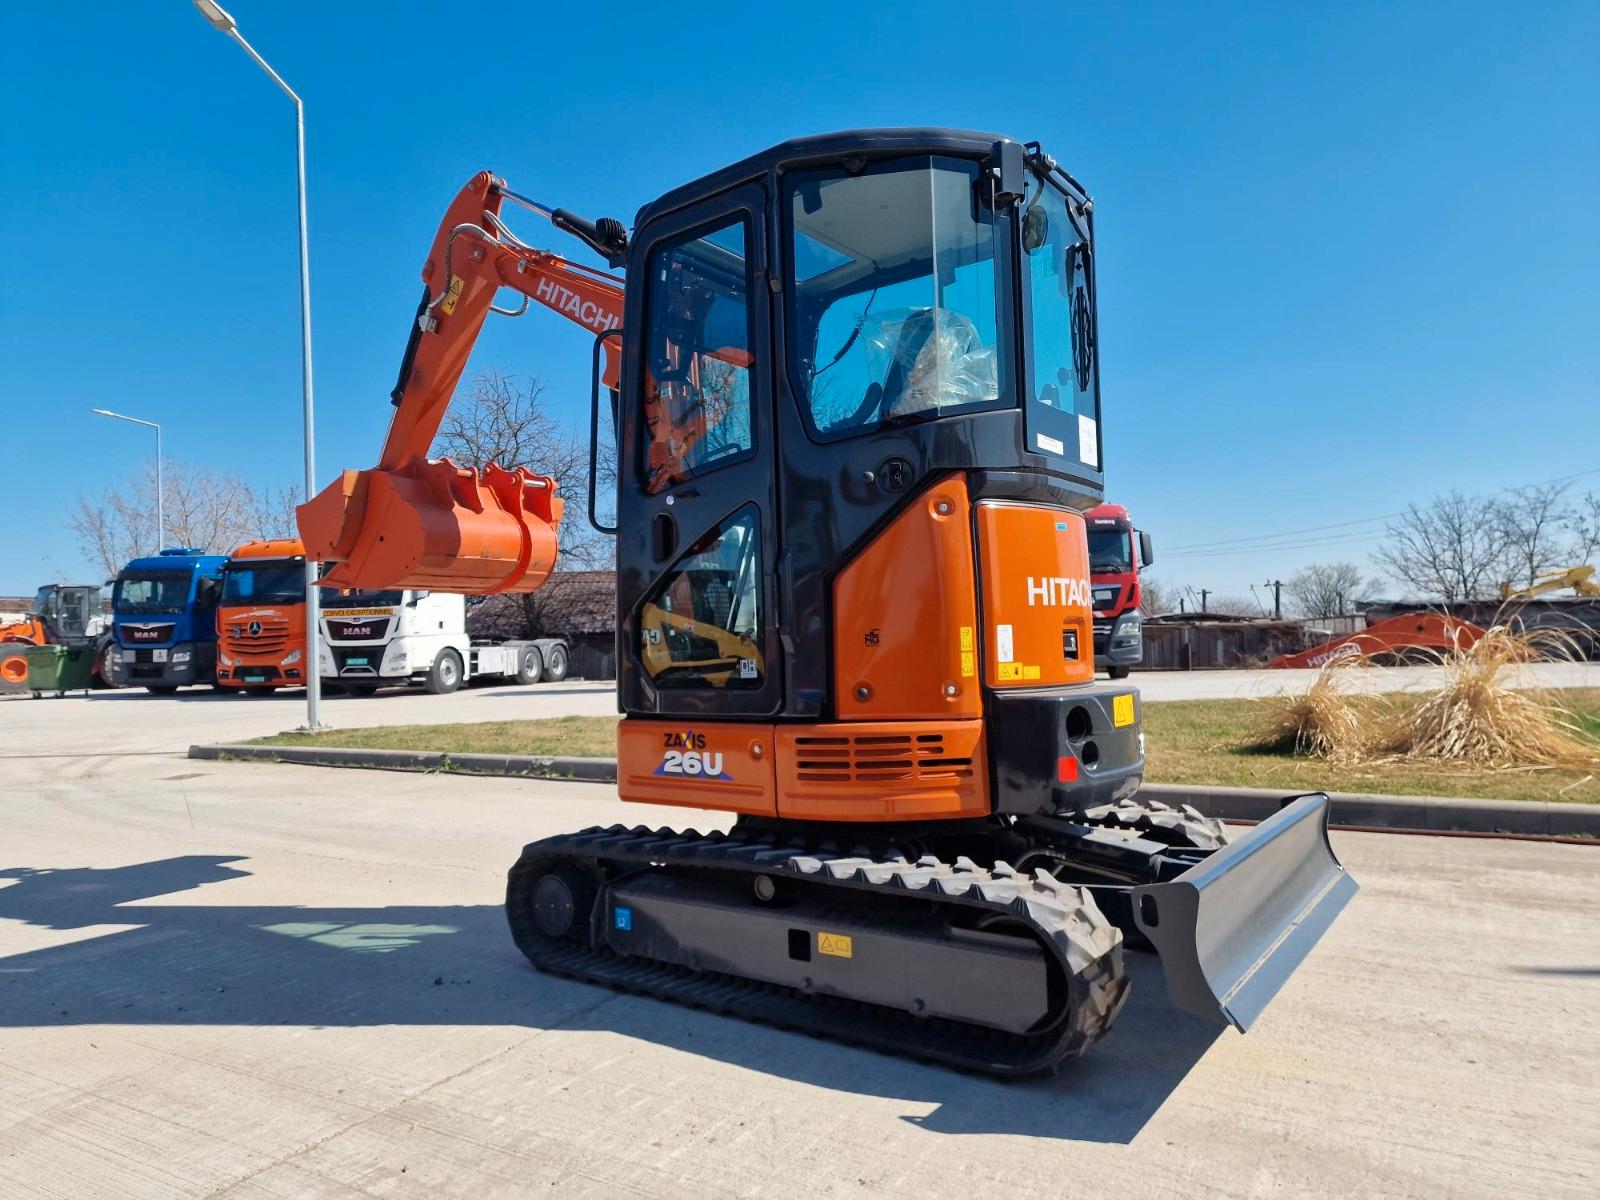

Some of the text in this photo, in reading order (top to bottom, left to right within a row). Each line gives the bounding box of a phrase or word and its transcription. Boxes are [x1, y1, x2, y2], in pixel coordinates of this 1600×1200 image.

[536, 277, 619, 332] HITACHI
[133, 631, 158, 639] MAN
[343, 627, 371, 635] MAN
[663, 750, 723, 776] 26U
